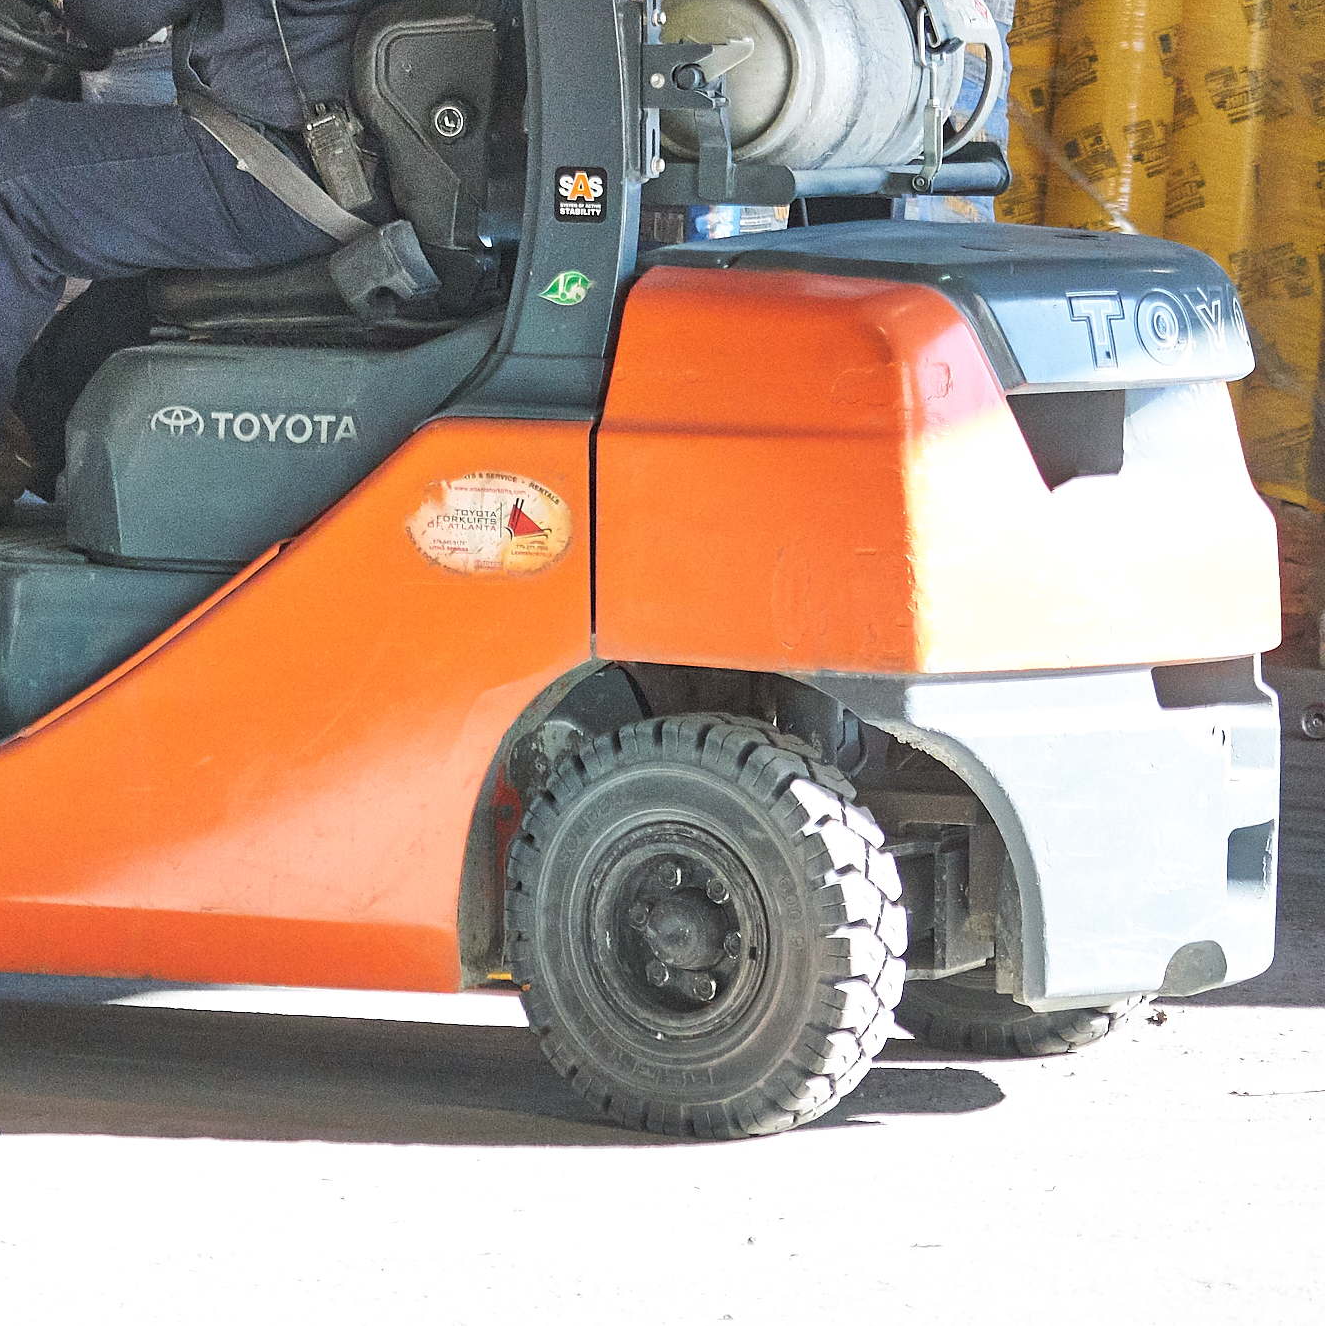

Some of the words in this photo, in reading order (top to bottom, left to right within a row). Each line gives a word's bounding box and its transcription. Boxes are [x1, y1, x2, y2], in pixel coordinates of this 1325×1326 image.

[559, 172, 604, 202] SAS
[560, 208, 601, 216] STABILITY
[211, 412, 358, 444] TOYOTA
[486, 473, 518, 483] SERVICE
[529, 482, 560, 505] RENTALS
[455, 509, 497, 517] TOYOTA
[436, 515, 497, 524] FORKLIFTS
[449, 523, 497, 531] ATLANTA
